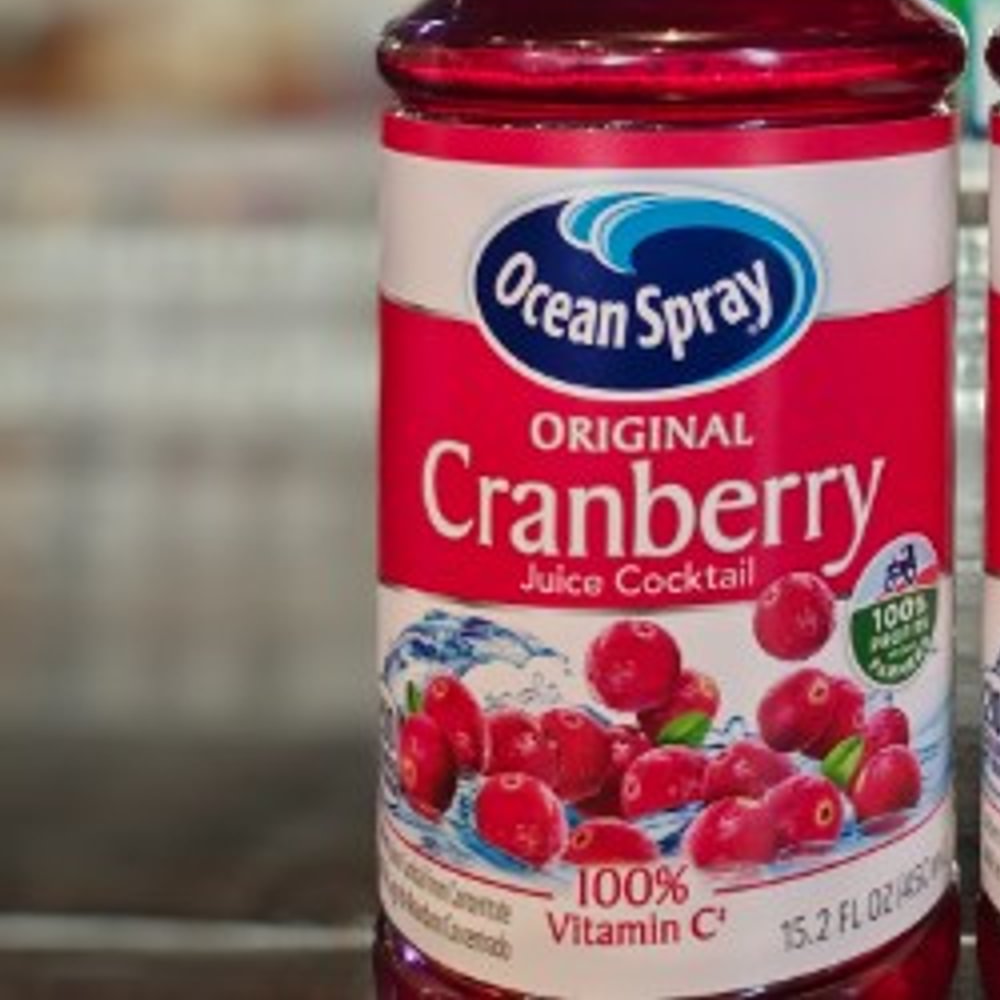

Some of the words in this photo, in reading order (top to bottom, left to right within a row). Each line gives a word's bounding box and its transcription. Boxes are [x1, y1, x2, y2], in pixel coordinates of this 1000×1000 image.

[494, 250, 627, 349] Ocean
[635, 259, 774, 361] Spray
[530, 411, 754, 453] ORIGINAL
[422, 440, 887, 578] Cranberry
[520, 563, 602, 596] Juice
[615, 557, 757, 595] Cocktail
[577, 864, 690, 908] 100%
[545, 910, 681, 946] Vitamin
[780, 907, 831, 951] 15.2
[839, 899, 861, 934] FL
